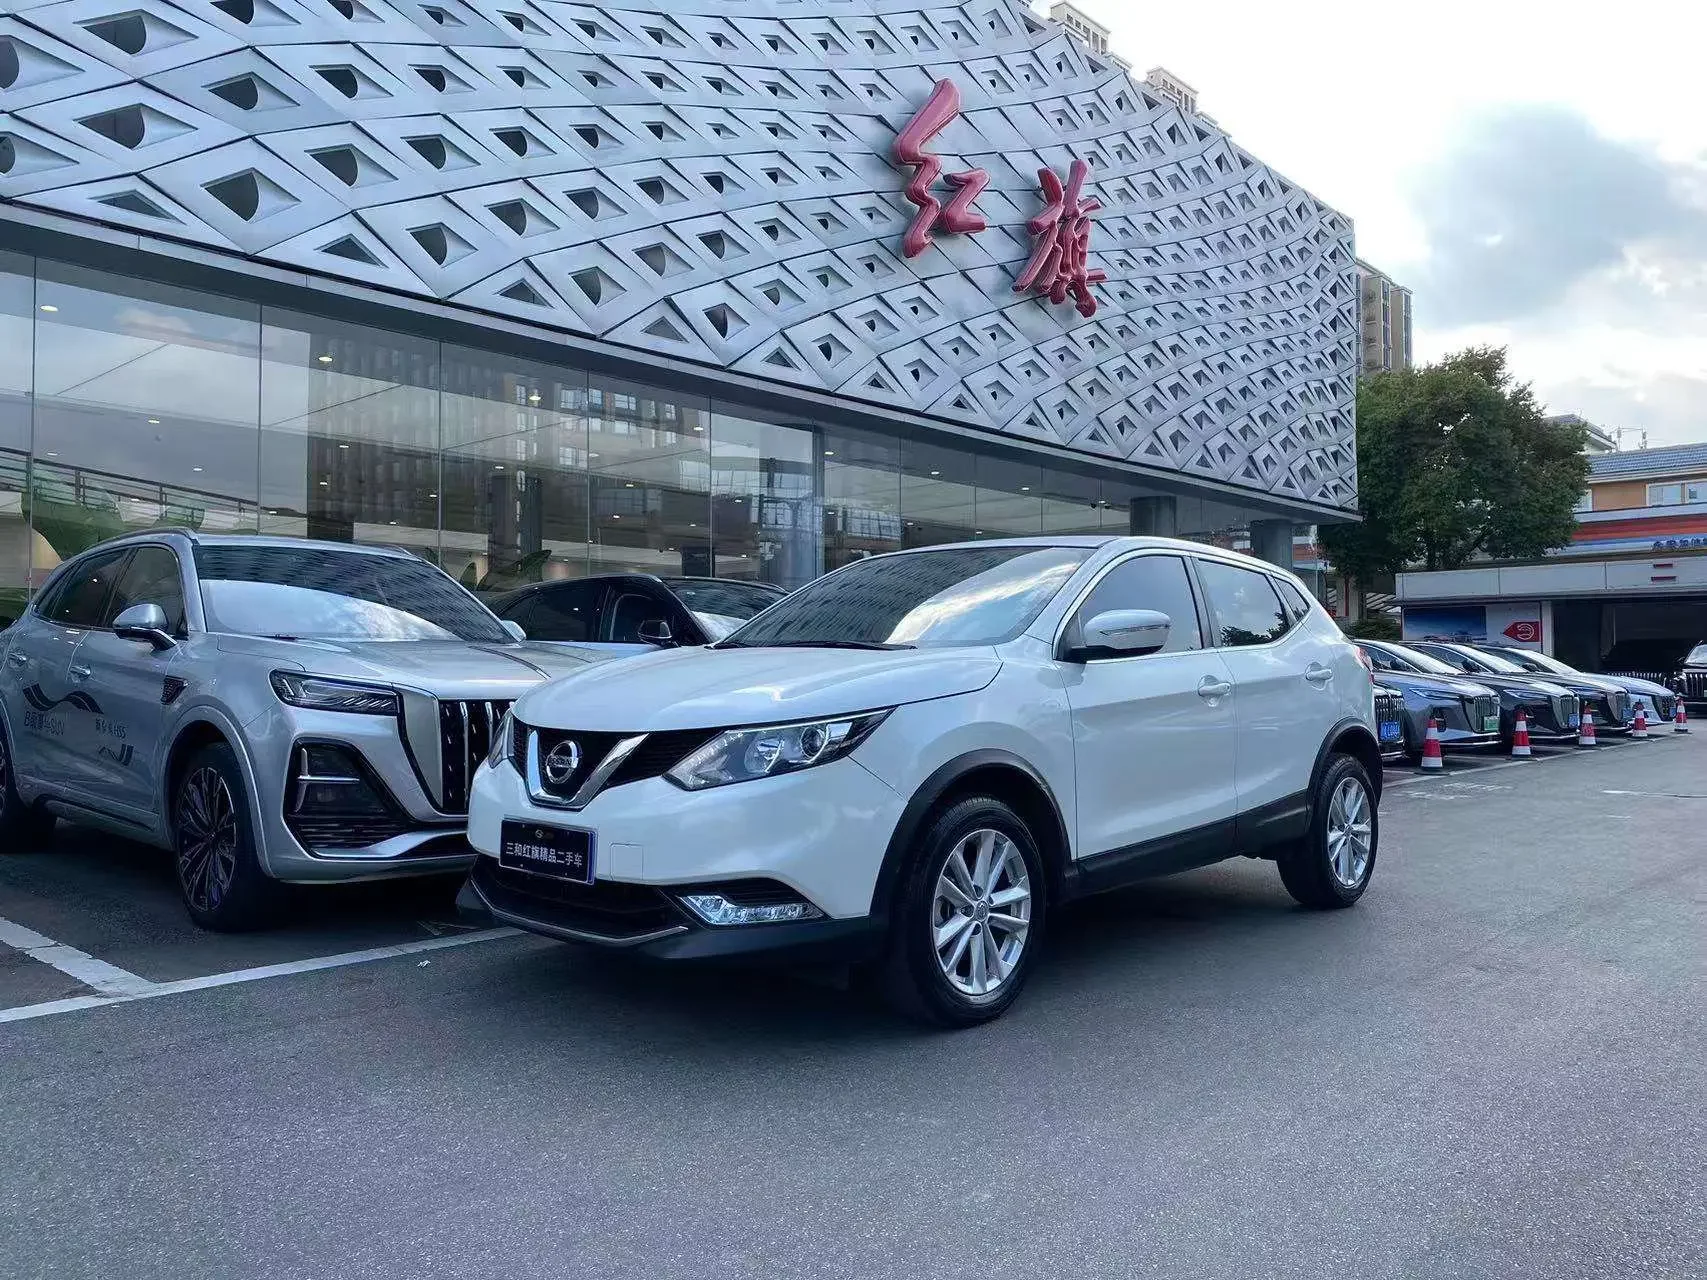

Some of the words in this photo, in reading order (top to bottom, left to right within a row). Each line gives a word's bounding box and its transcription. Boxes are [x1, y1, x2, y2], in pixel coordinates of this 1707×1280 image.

[893, 78, 1107, 318] 红旗
[505, 842, 583, 868] 三和红旗精品二手车
